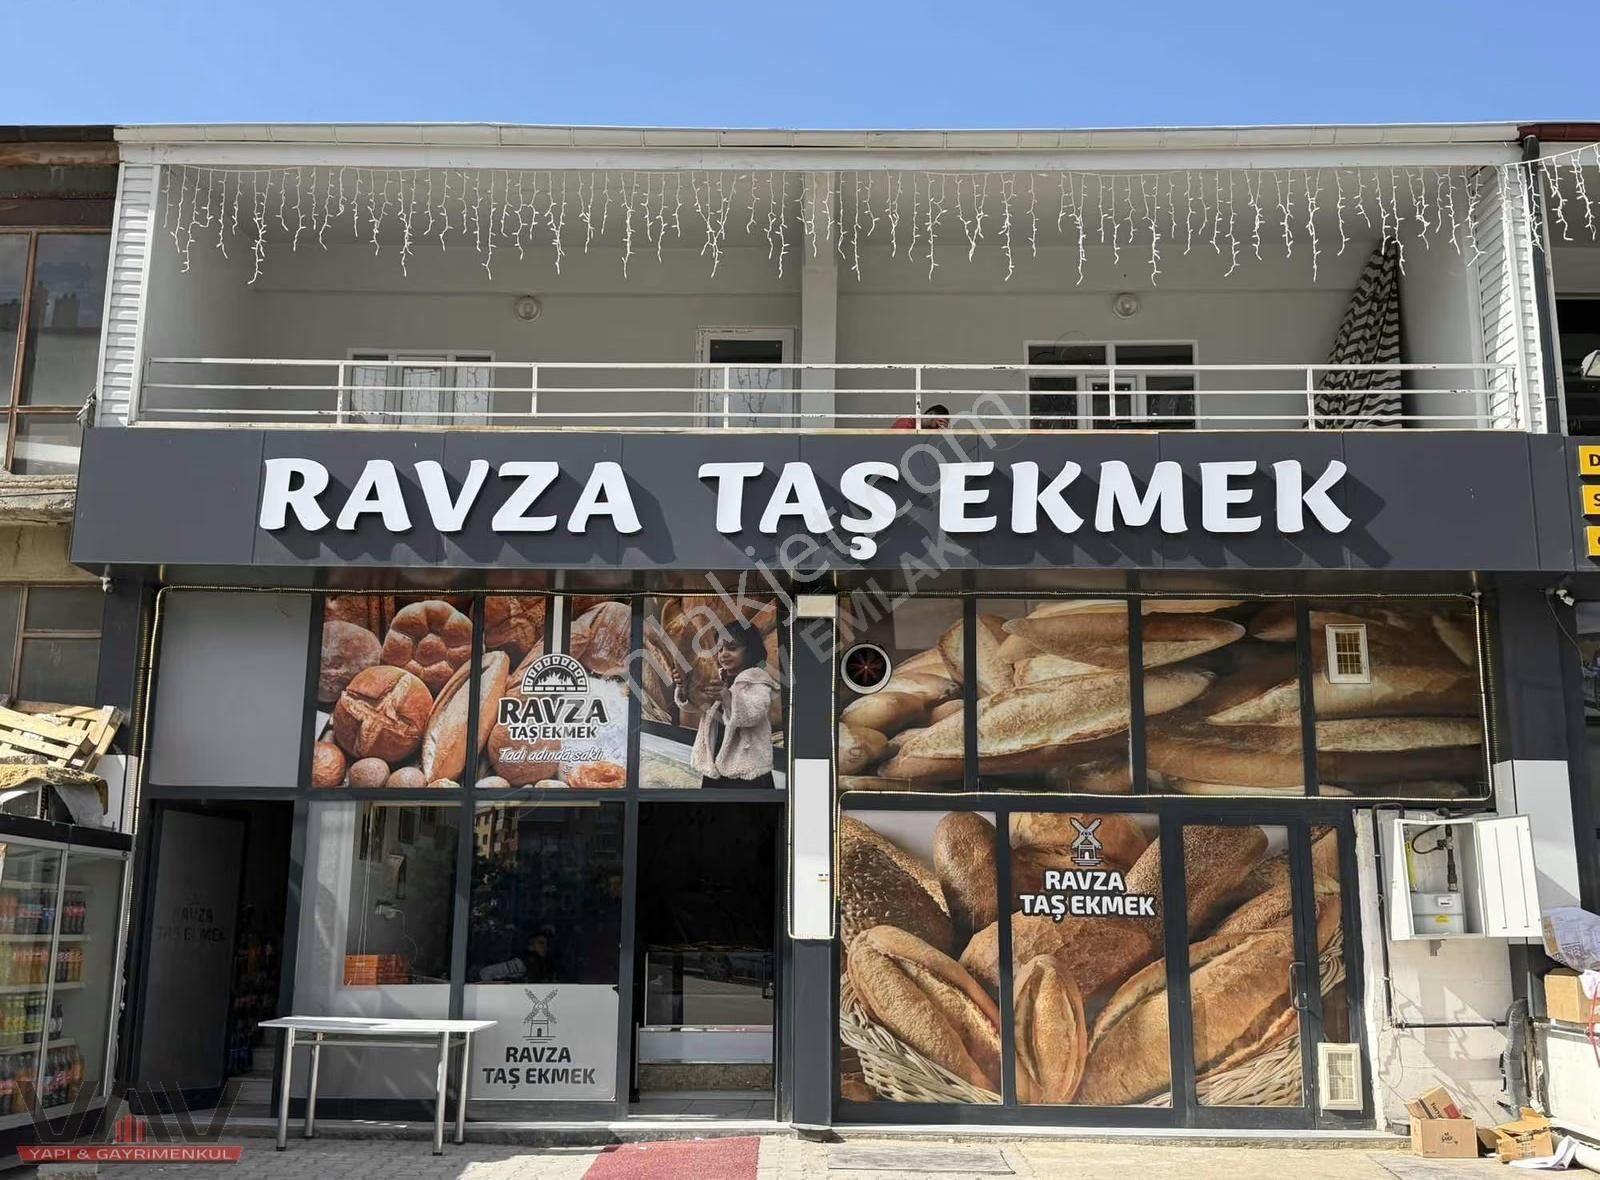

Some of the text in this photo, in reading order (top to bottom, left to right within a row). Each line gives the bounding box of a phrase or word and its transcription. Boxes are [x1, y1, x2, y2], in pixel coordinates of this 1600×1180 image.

[259, 457, 1352, 561] RAVZA TAŞ EKMEK
[498, 697, 609, 725] RAVZA
[509, 725, 598, 744] TAŞ EKMEK
[1044, 870, 1125, 891] RAVZA
[1019, 894, 1156, 920] TAŞ EKMEK
[504, 1046, 572, 1063] RAVZA
[482, 1067, 596, 1090] TAŞ EKMEK
